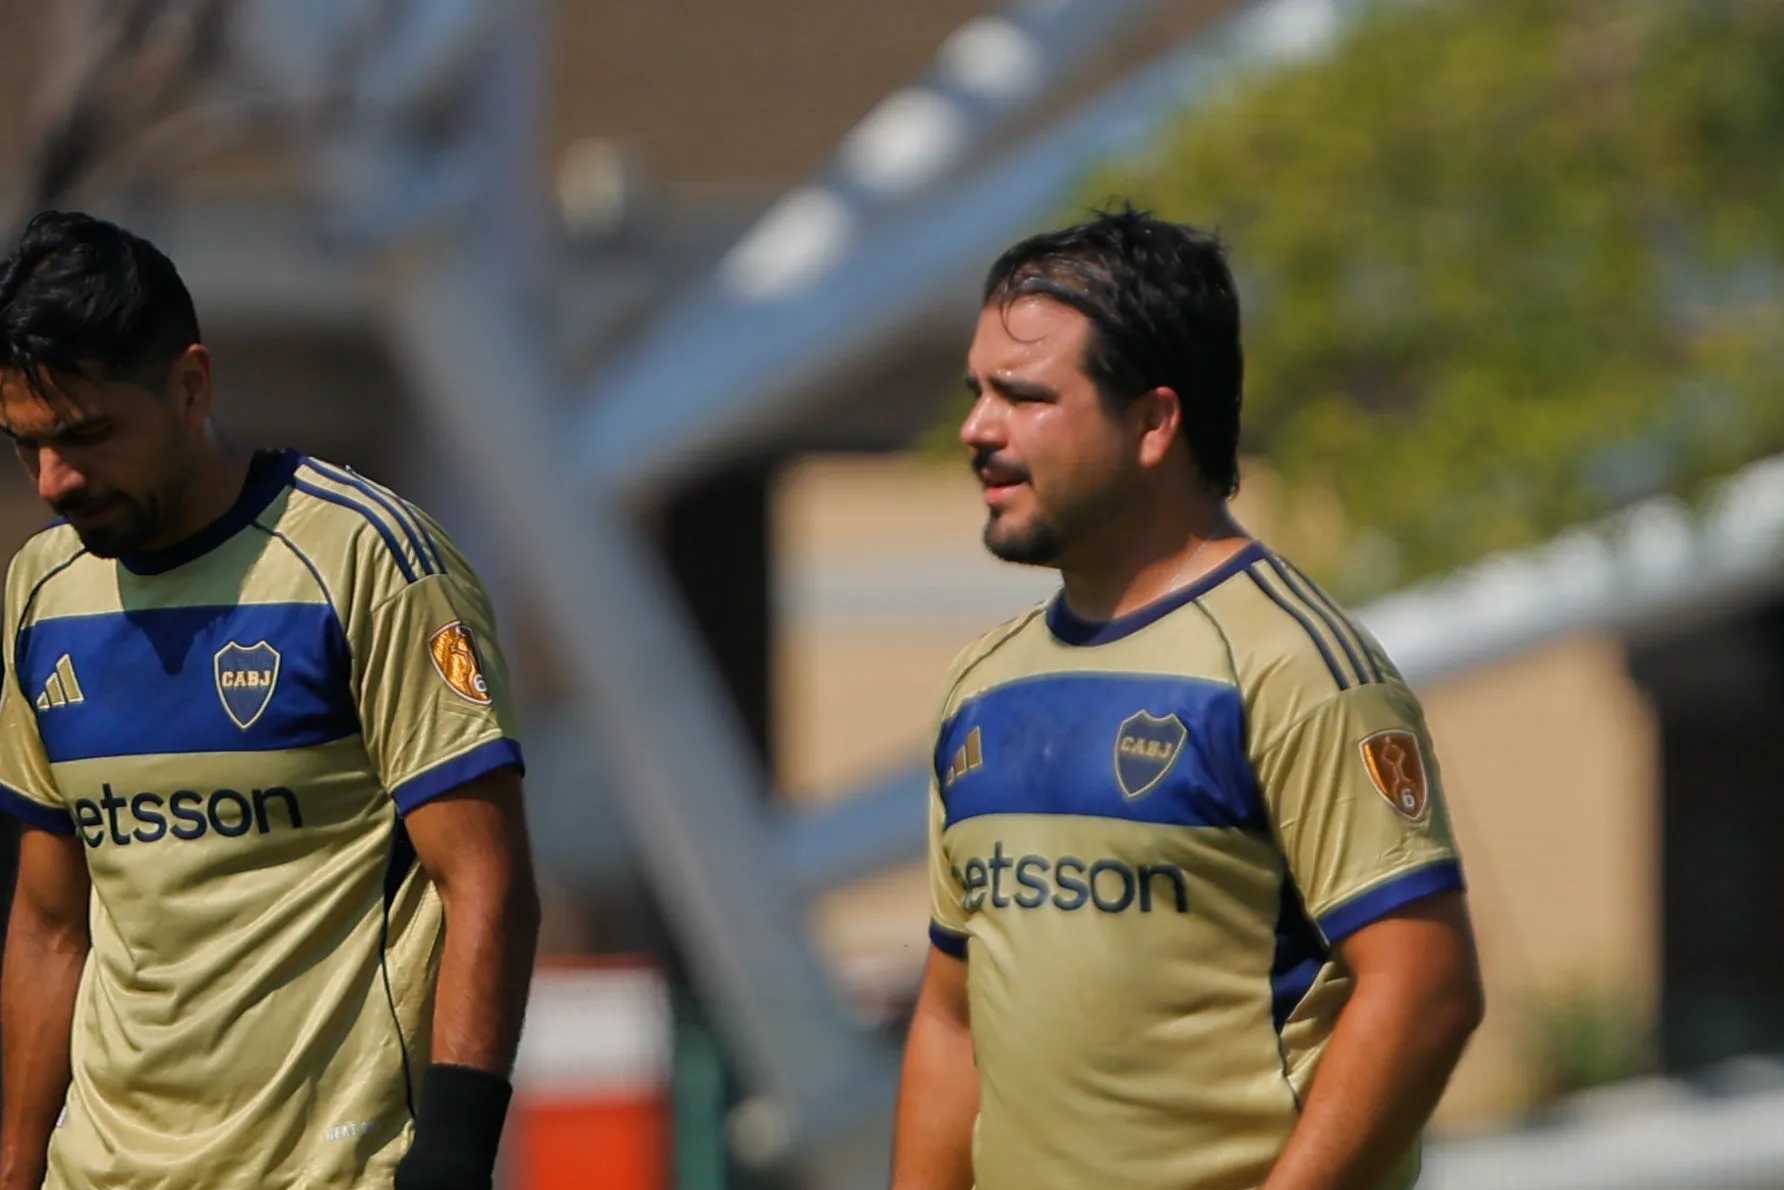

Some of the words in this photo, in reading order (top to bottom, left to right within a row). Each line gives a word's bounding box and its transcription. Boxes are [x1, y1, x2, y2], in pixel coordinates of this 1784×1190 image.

[221, 670, 272, 688] CABJ
[473, 673, 488, 693] 6
[1121, 736, 1173, 758] CABJ
[1401, 788, 1416, 809] 6
[76, 783, 303, 848] etsson
[953, 841, 1188, 914] etsson
